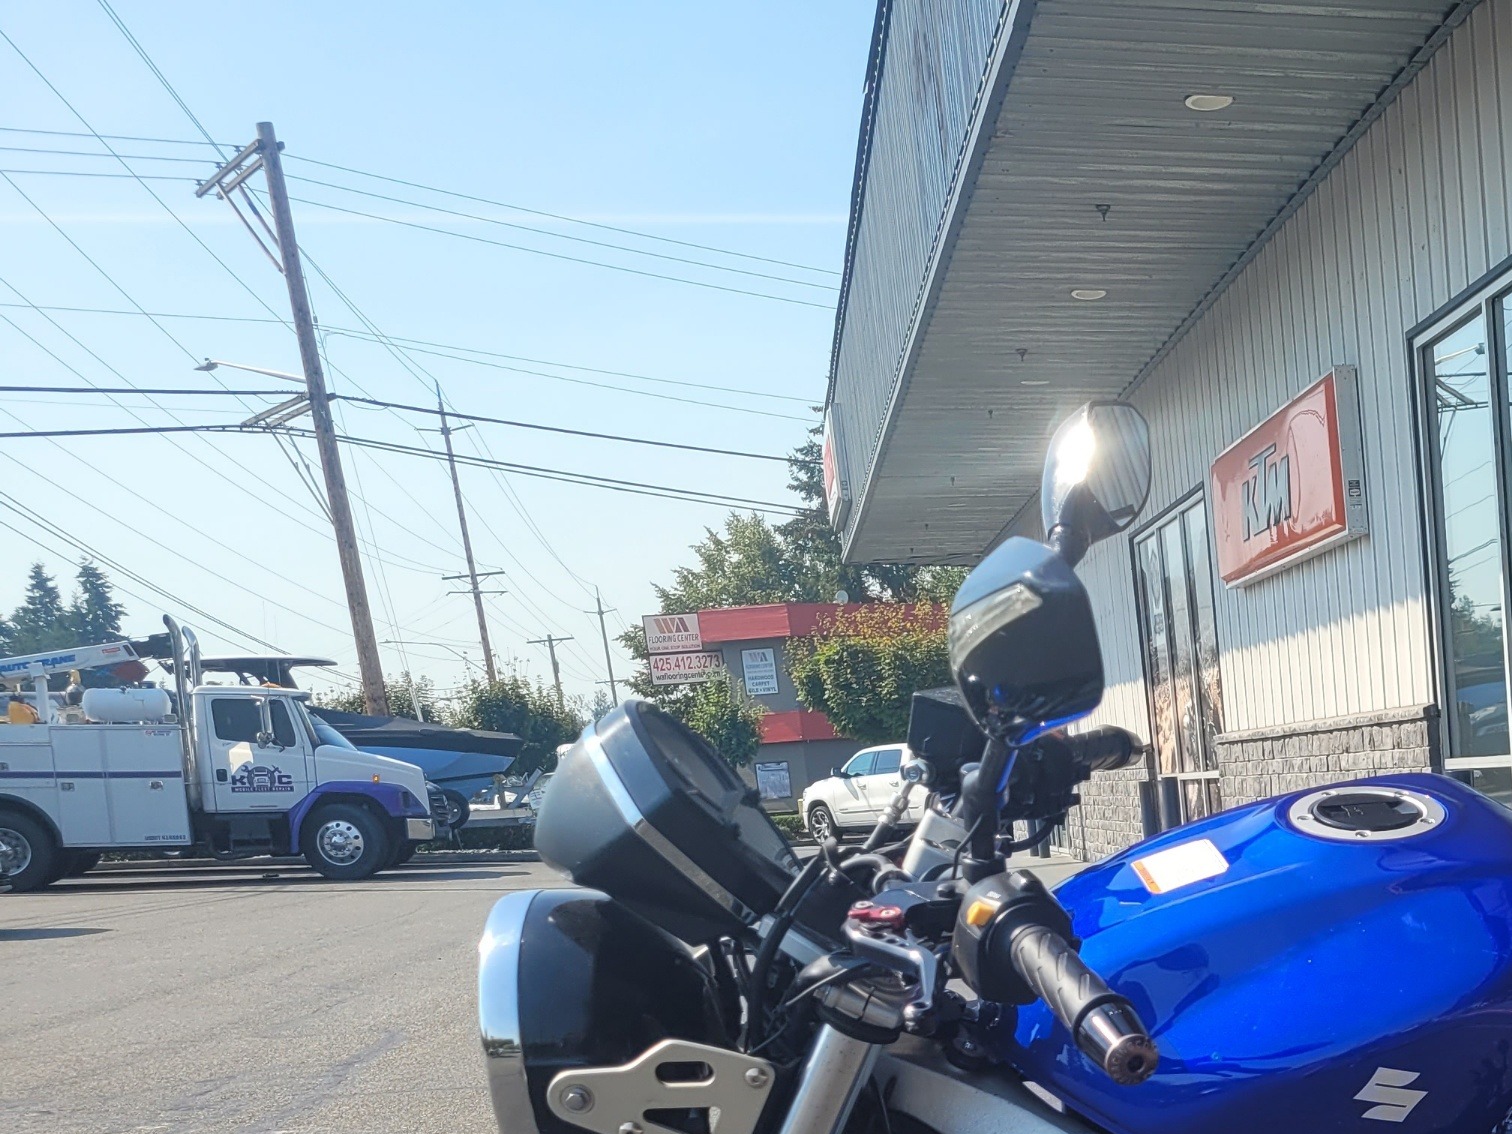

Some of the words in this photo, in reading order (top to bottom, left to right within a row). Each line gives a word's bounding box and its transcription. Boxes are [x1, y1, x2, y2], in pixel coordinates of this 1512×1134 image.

[1242, 443, 1291, 542] KTM
[649, 635, 676, 644] FLOORING
[677, 633, 699, 642] CENTER
[653, 655, 720, 672] 425.412.3273
